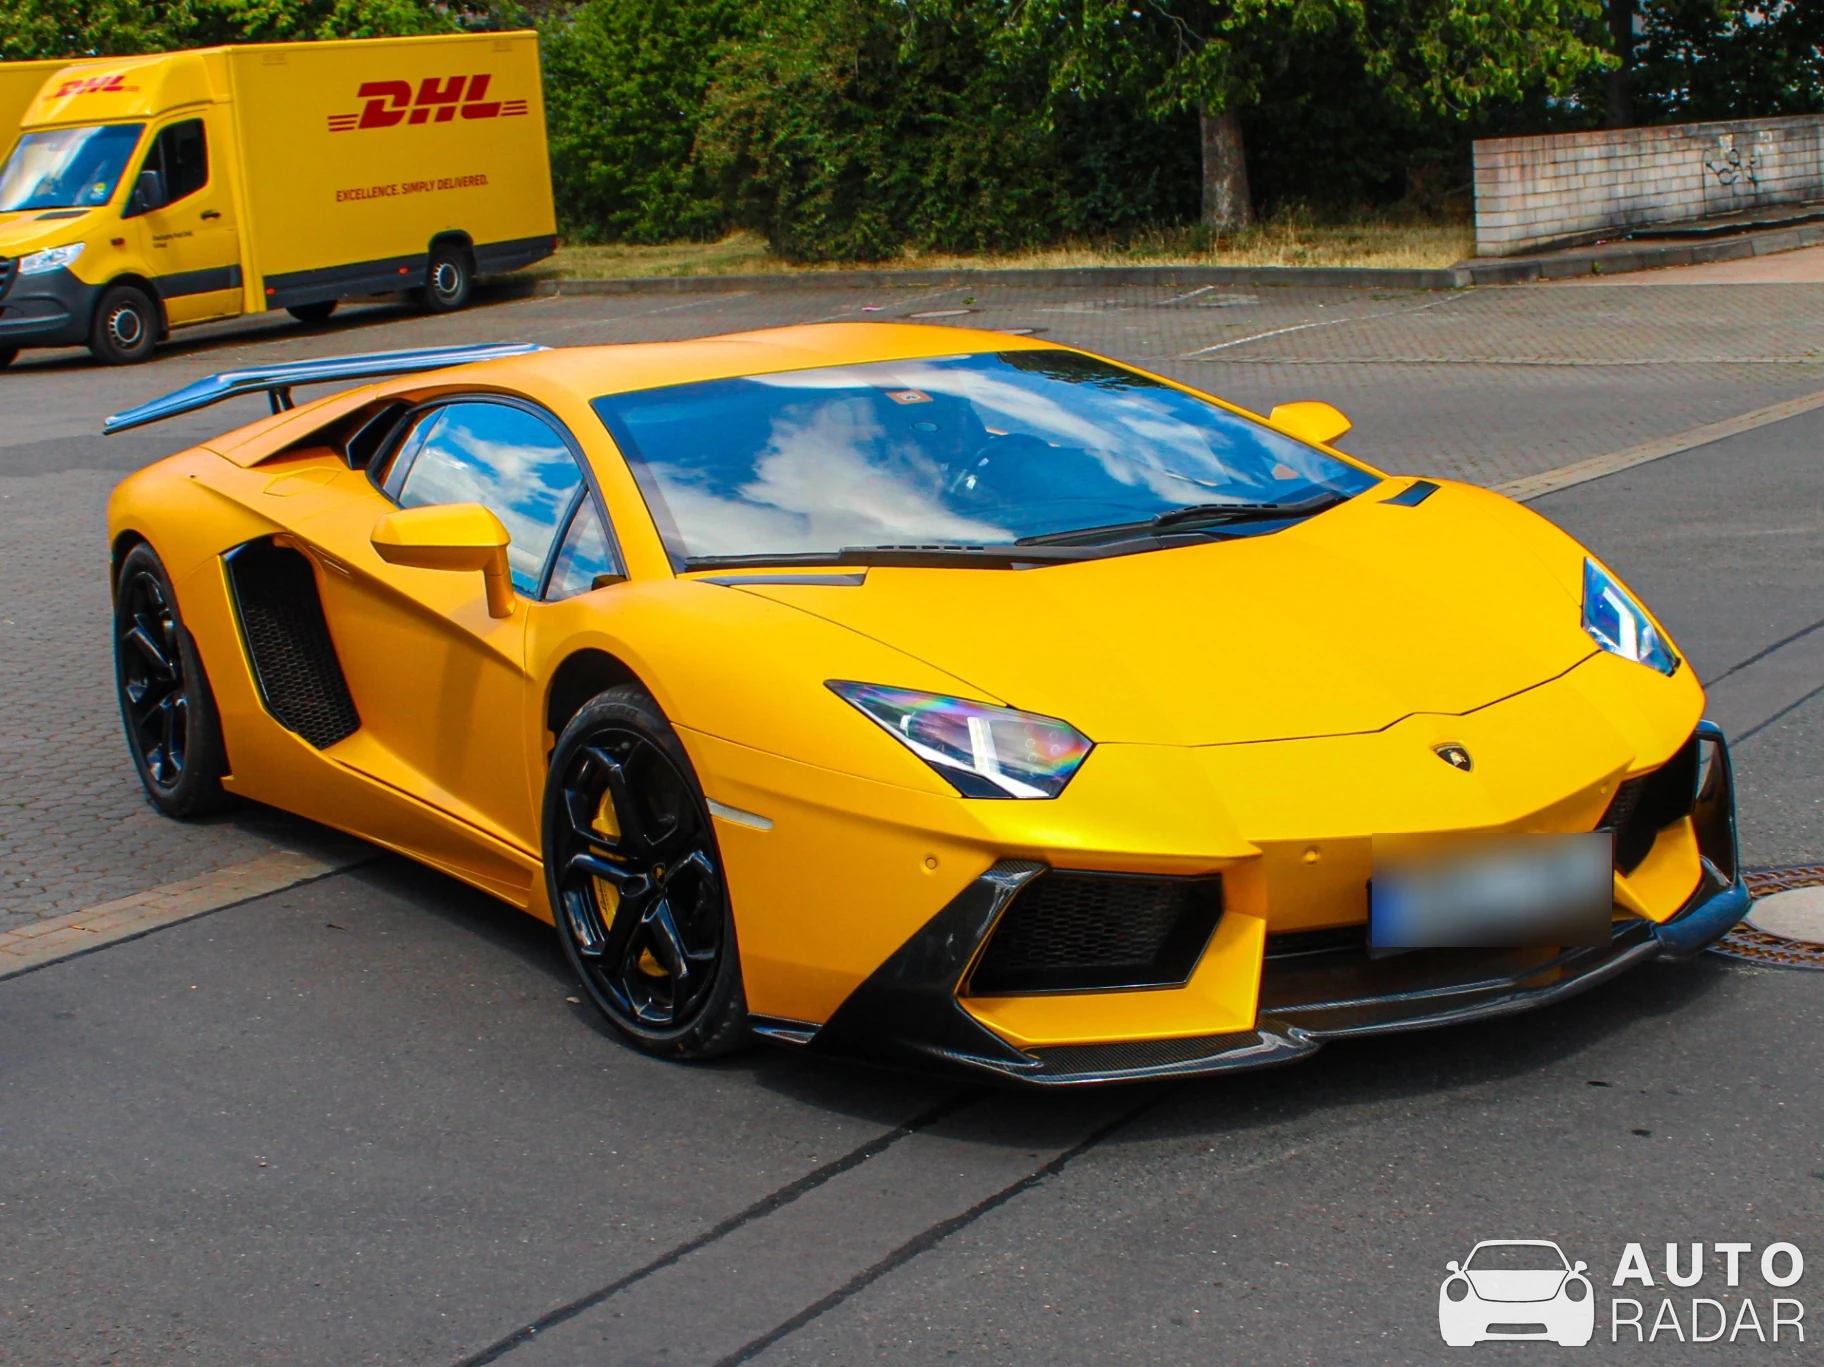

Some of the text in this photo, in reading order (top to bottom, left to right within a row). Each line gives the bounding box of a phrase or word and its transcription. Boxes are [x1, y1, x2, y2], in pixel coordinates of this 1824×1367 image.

[54, 76, 126, 98] DHL
[357, 74, 502, 129] DHL
[336, 174, 489, 202] EXCELLENCE. SIMPLY DELIVERED.
